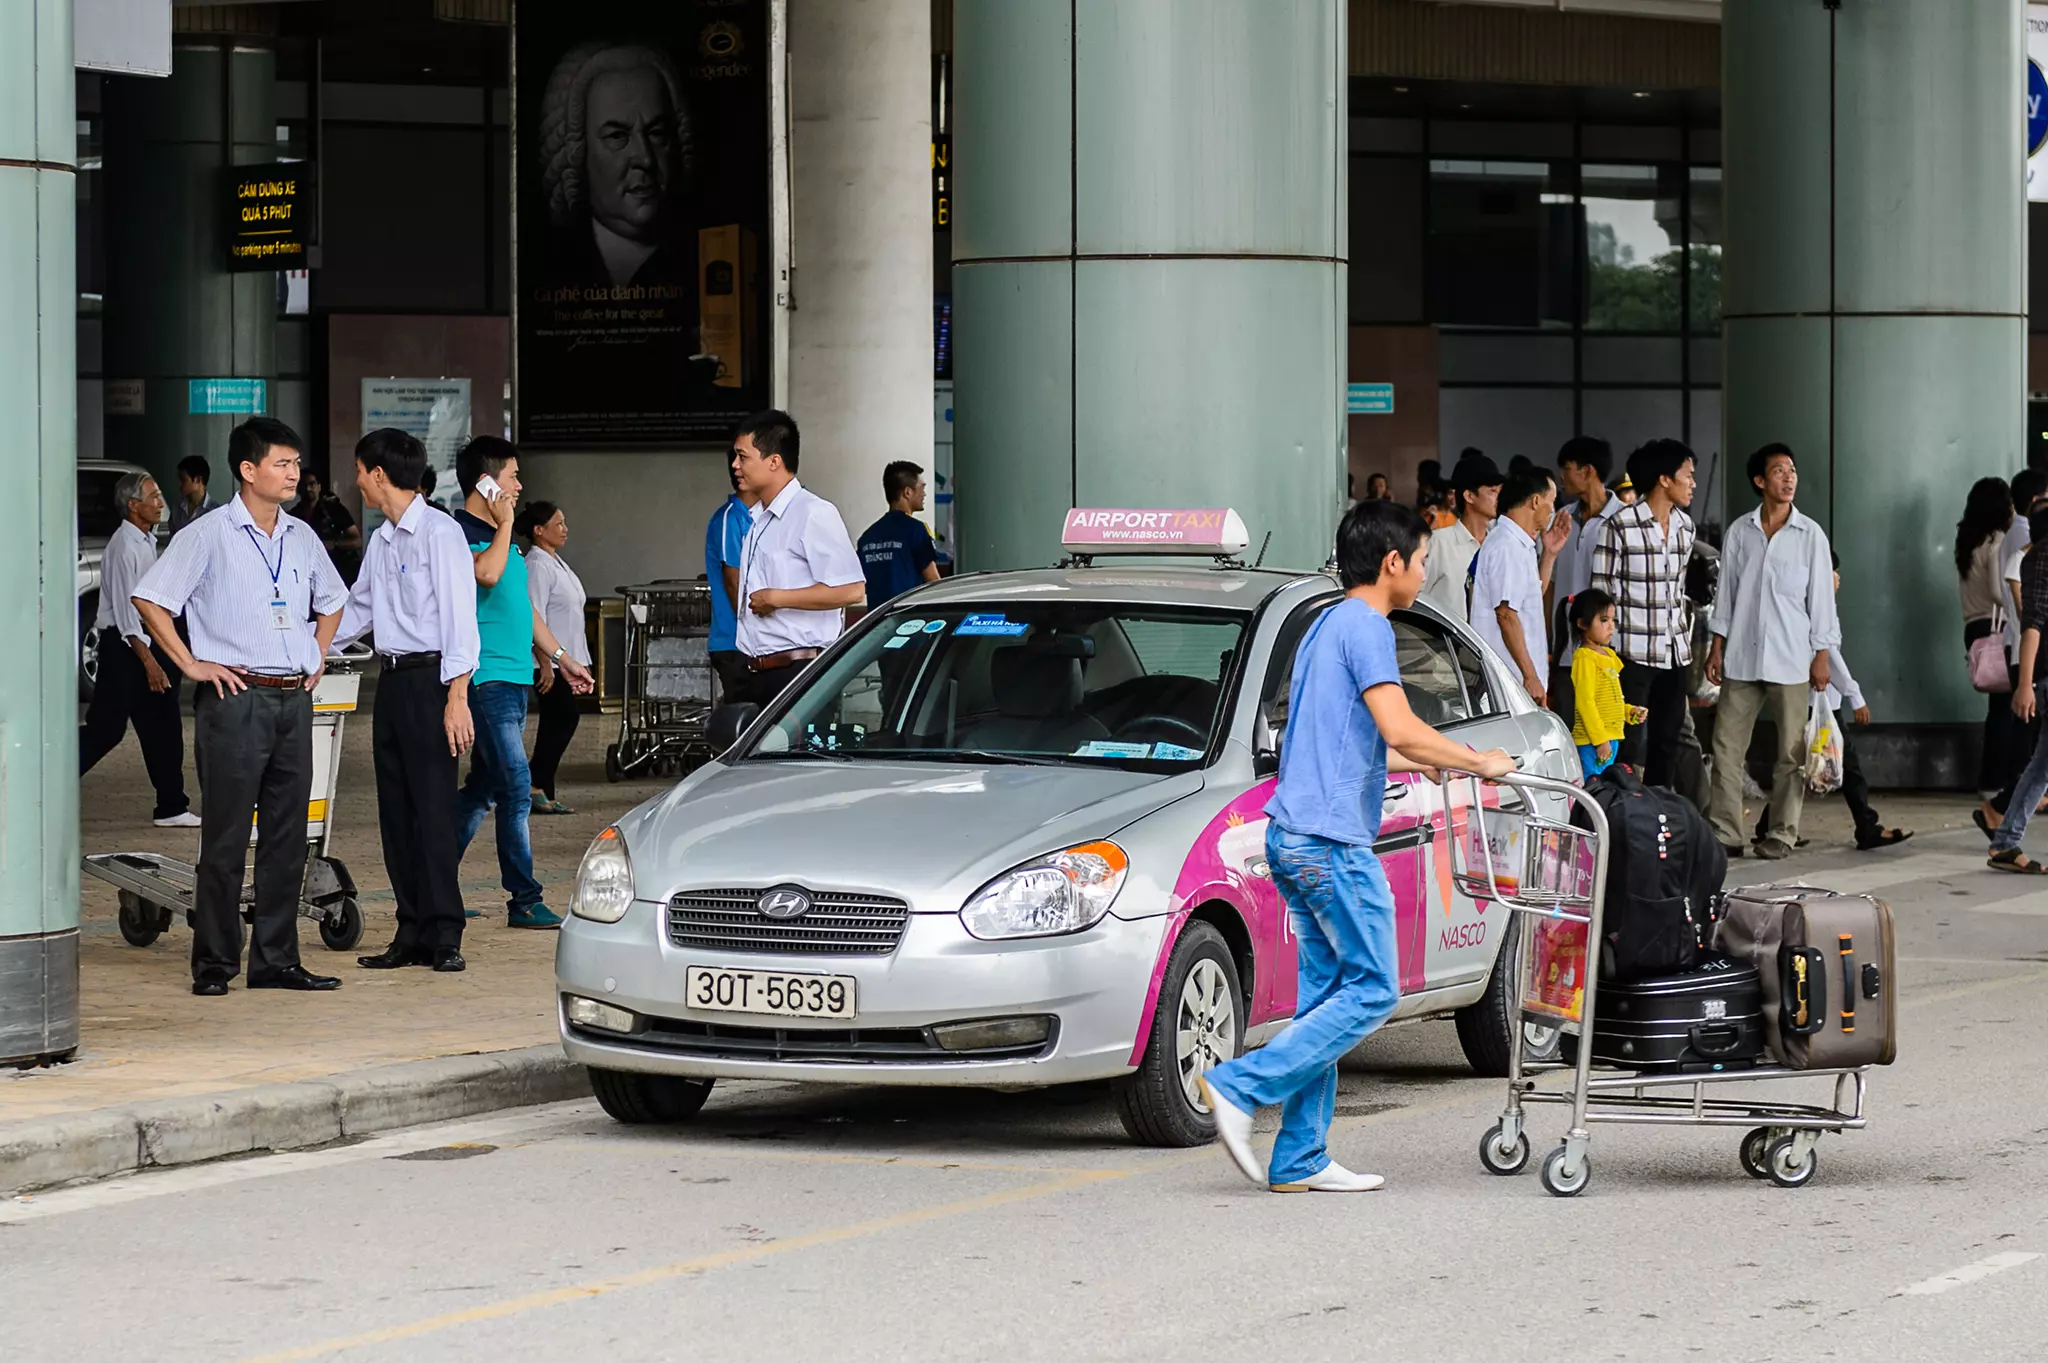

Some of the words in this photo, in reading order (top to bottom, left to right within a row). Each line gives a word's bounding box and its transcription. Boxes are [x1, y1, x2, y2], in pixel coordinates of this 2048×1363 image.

[285, 181, 296, 195] XE
[241, 203, 261, 221] QUÁ
[262, 206, 268, 220] 5
[269, 201, 292, 219] PHÚT
[275, 241, 280, 254] 5
[610, 284, 646, 301] danh
[605, 307, 618, 321] for
[620, 307, 637, 320] the
[1102, 530, 1184, 540] www.nasco.vn
[1438, 920, 1486, 952] NASCO
[697, 972, 845, 1013] 30T-5639
